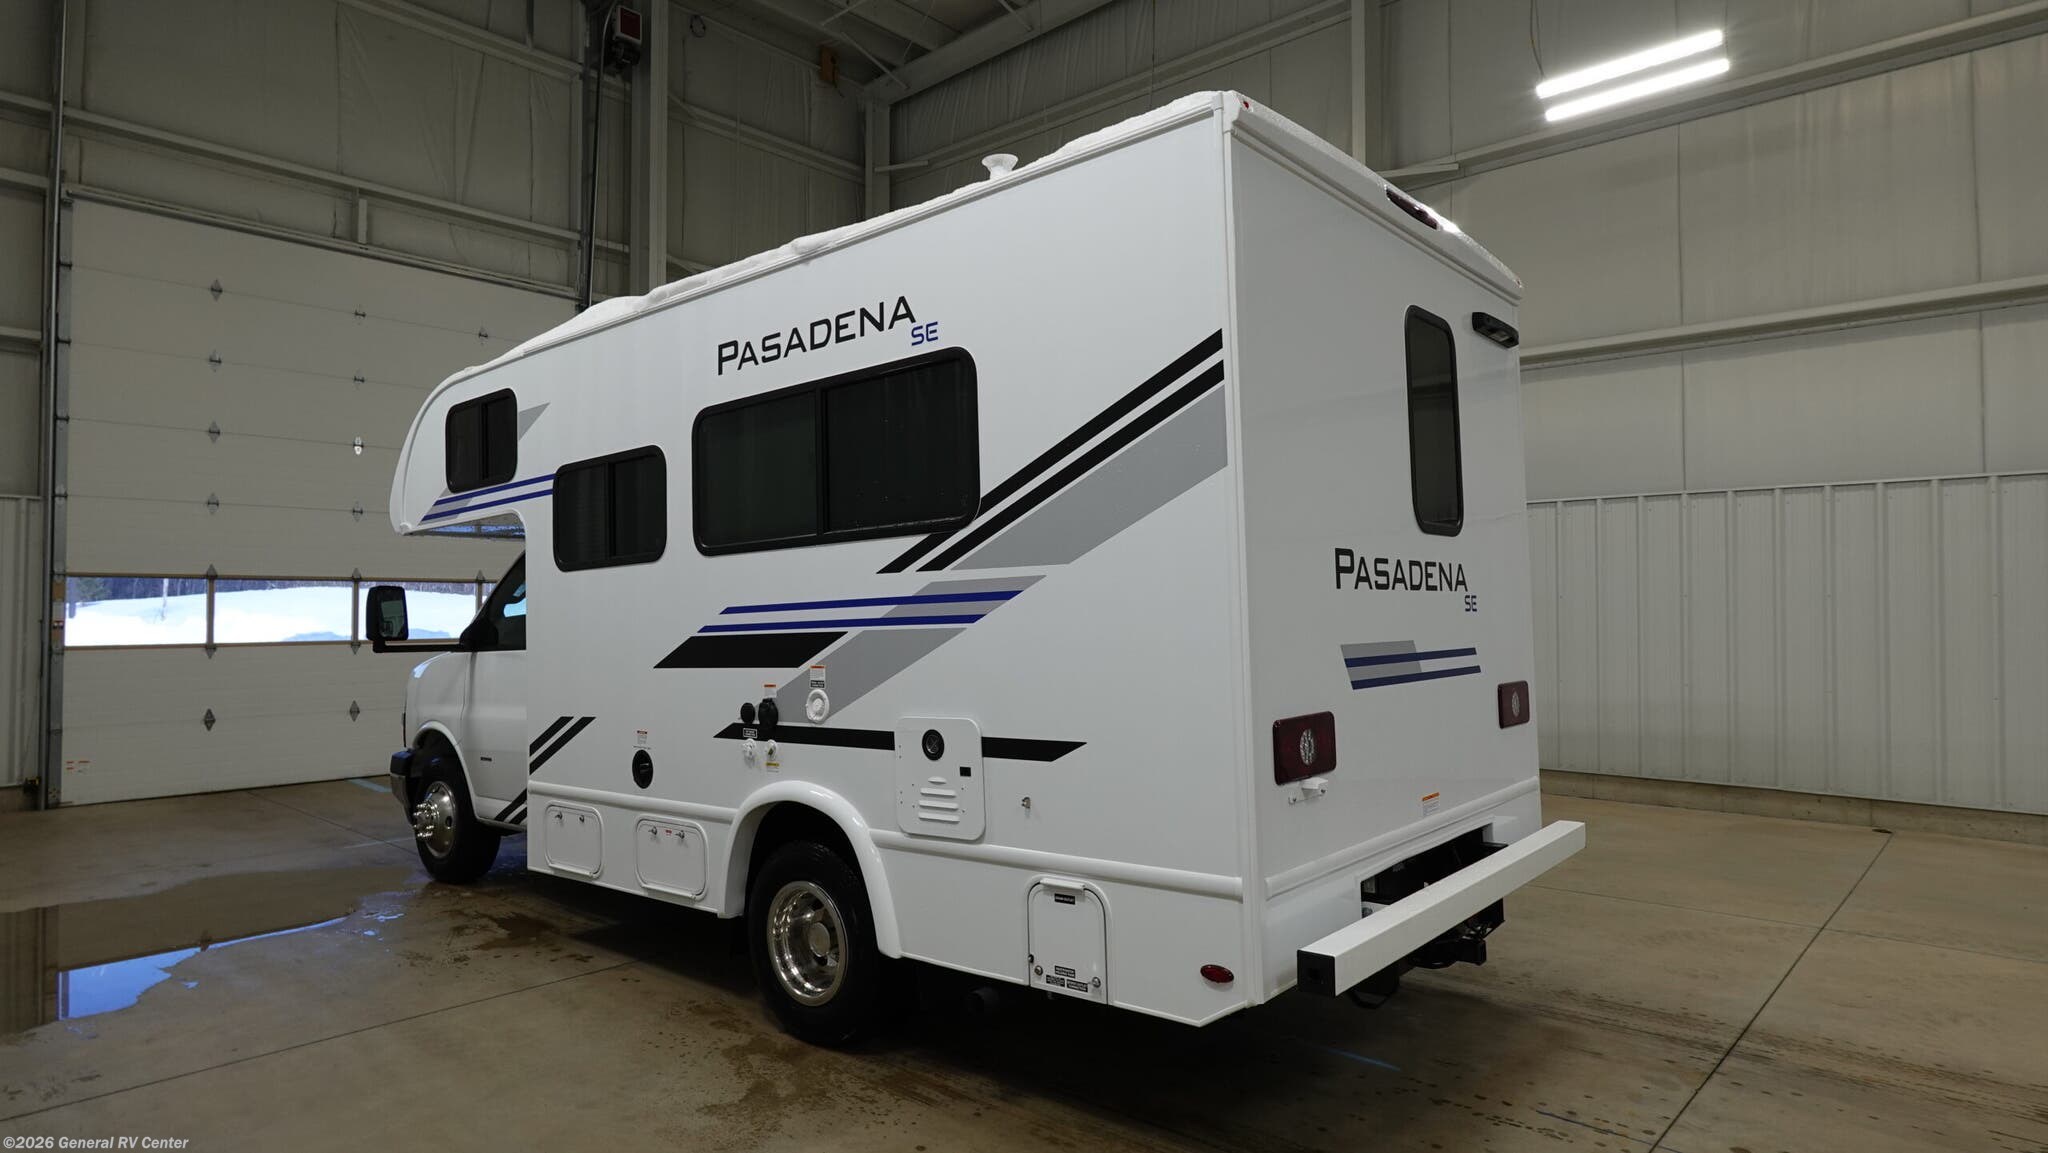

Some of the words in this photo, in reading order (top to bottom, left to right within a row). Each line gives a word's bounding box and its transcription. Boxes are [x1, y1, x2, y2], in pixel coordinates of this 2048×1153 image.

[717, 295, 917, 376] PASADENA
[911, 321, 939, 346] SE
[1334, 547, 1468, 592] PASADENA
[1464, 595, 1478, 612] SE
